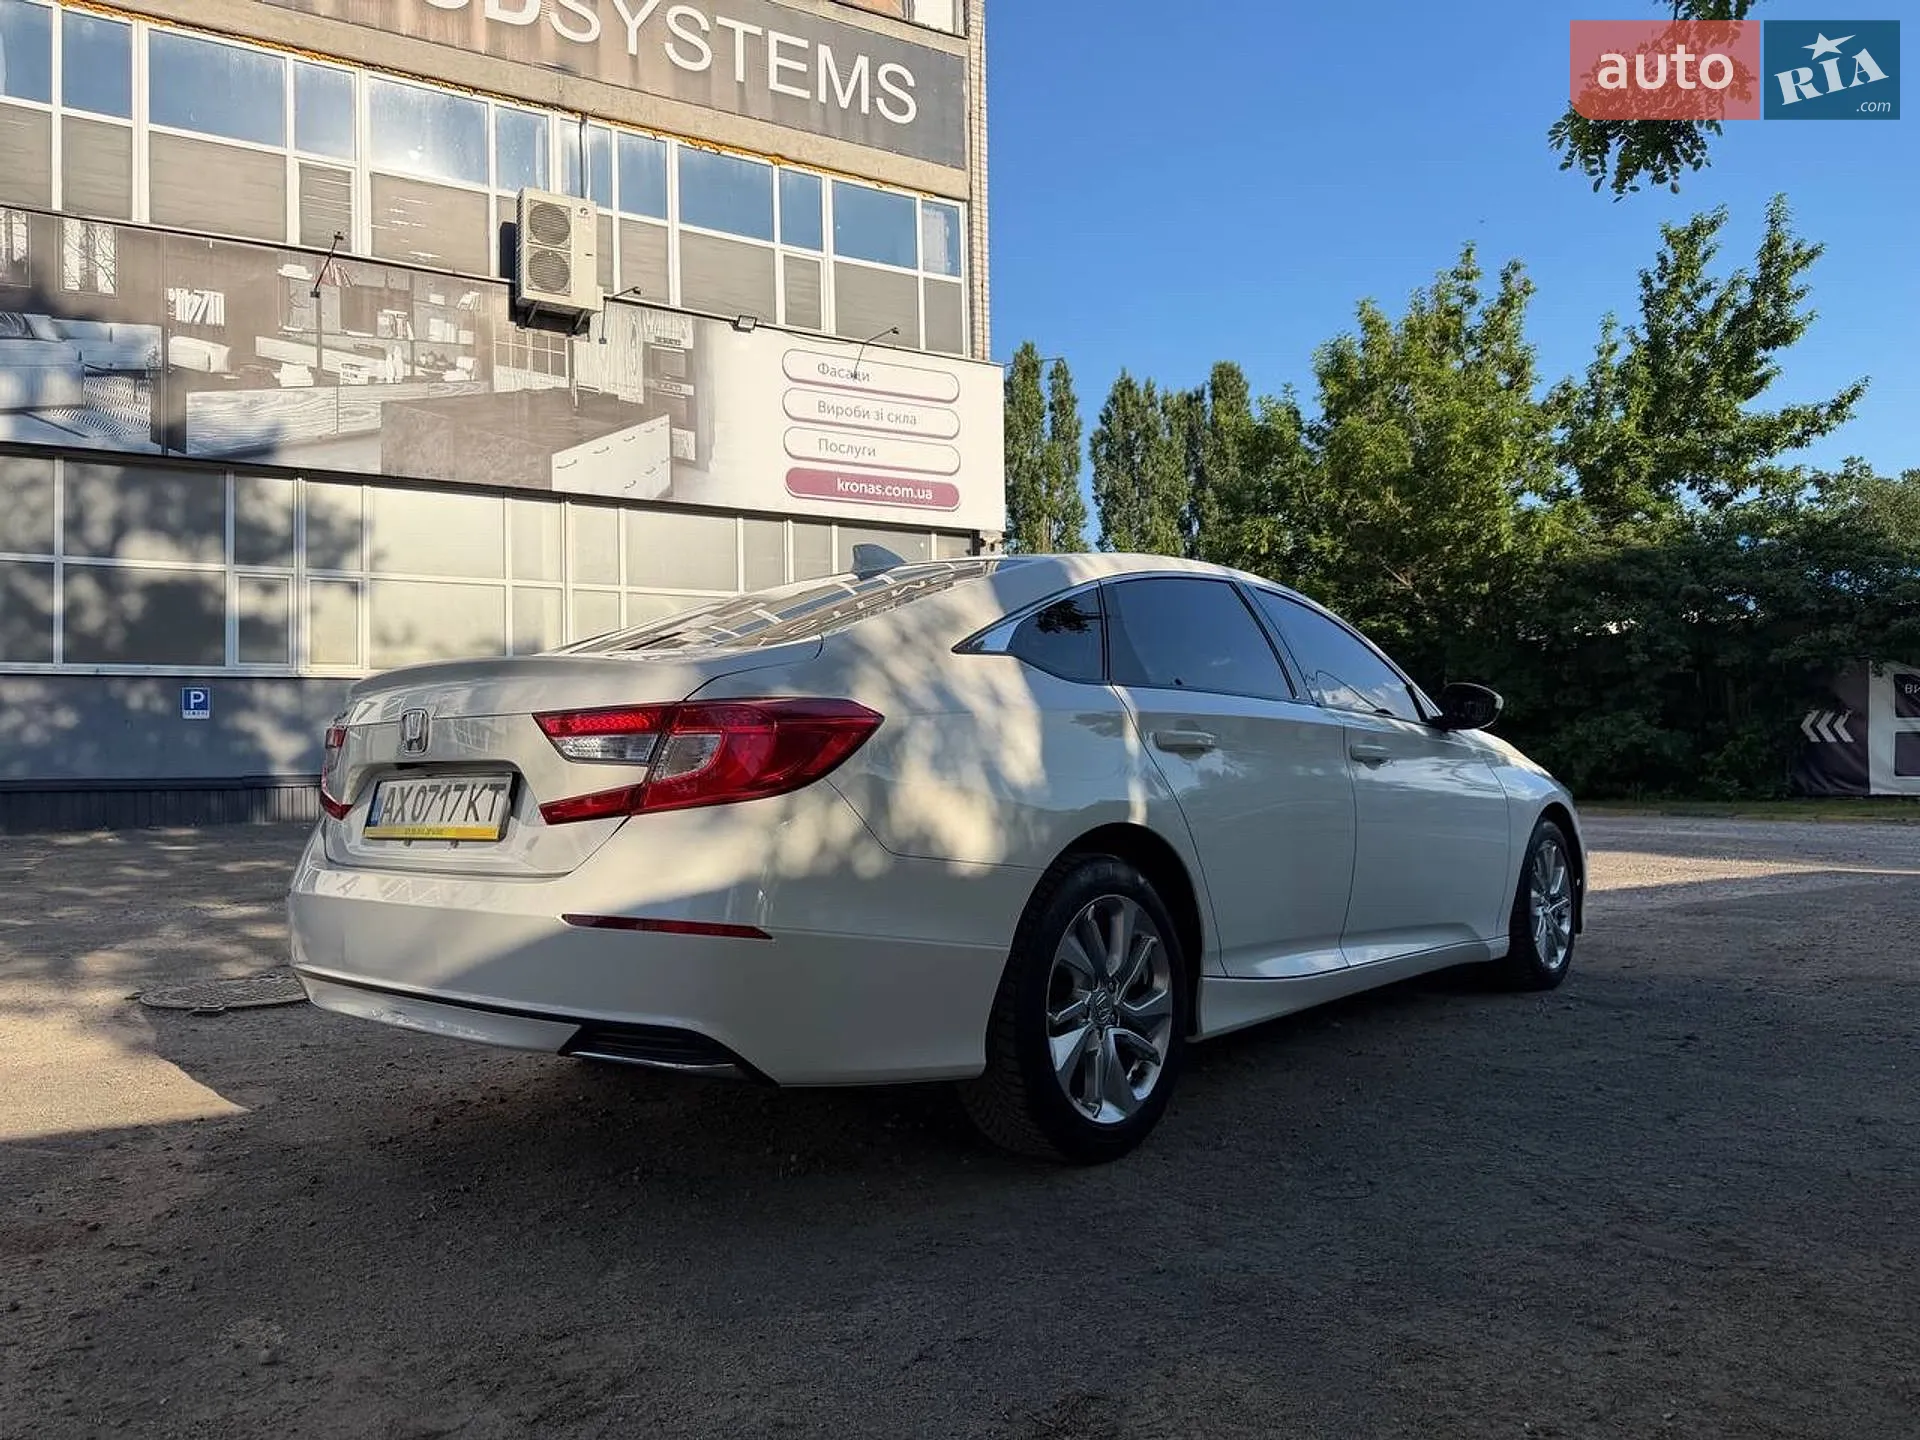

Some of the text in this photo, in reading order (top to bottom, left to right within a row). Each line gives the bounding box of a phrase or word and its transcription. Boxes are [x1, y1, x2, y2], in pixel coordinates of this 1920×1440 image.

[817, 400, 871, 420] Вироби
[886, 412, 917, 426] скла
[818, 438, 876, 458] Послуги
[836, 478, 933, 500] kronas.com.ua
[190, 691, 204, 709] P
